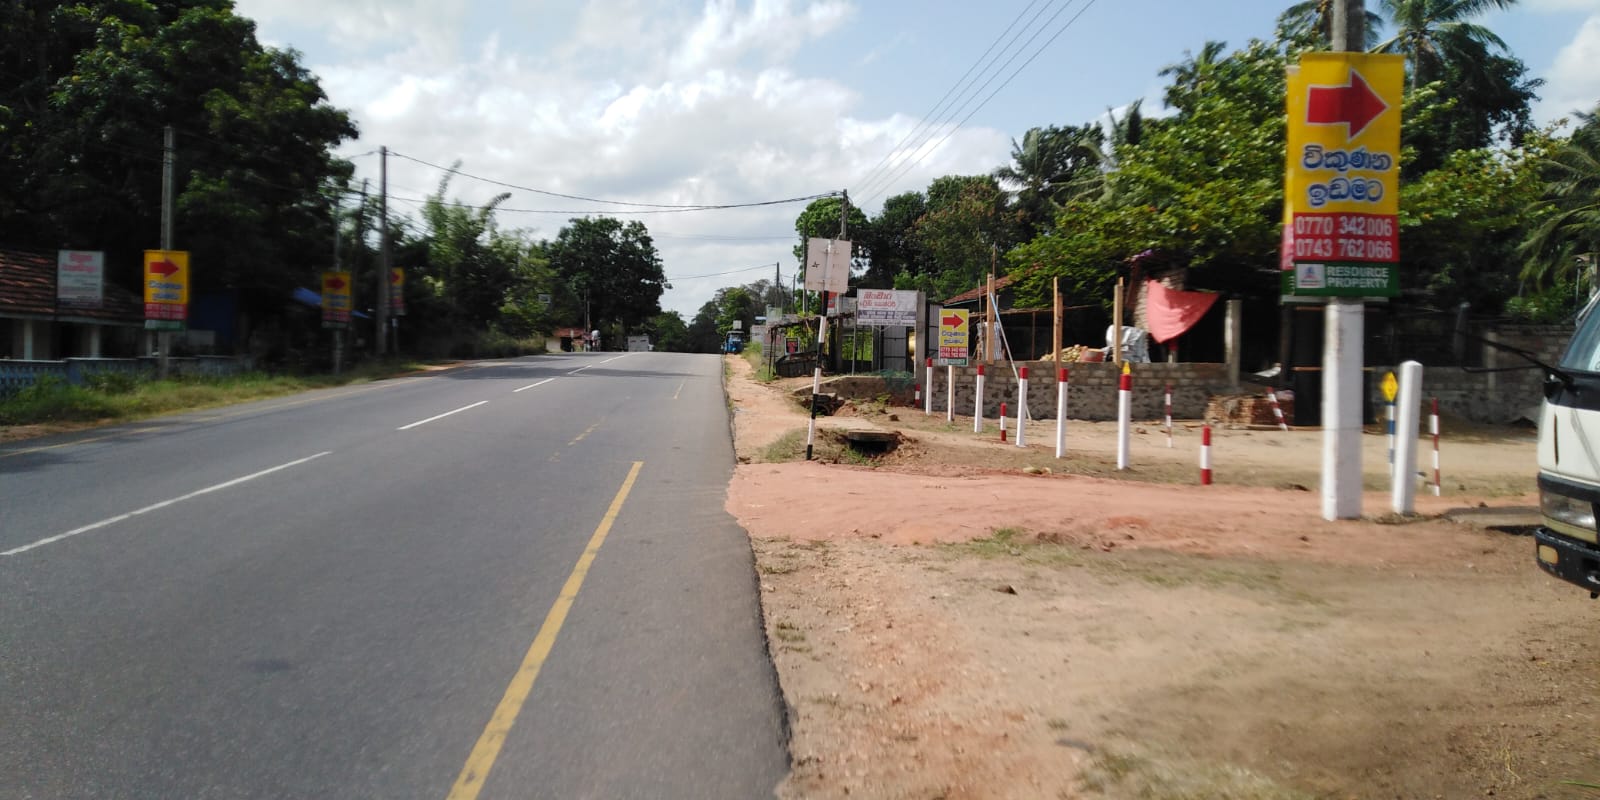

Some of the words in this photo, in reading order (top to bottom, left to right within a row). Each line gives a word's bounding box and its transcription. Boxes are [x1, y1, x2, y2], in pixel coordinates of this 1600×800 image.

[1308, 177, 1384, 206] ඉඩමට
[1296, 216, 1333, 235] 0770
[1339, 216, 1365, 235] 342
[1367, 218, 1392, 236] 006
[1296, 239, 1332, 257] 0743
[1338, 239, 1364, 257] 762
[1367, 241, 1392, 258] 066
[1327, 266, 1390, 277] RESOURCE
[1327, 277, 1390, 288] PROPERTY
